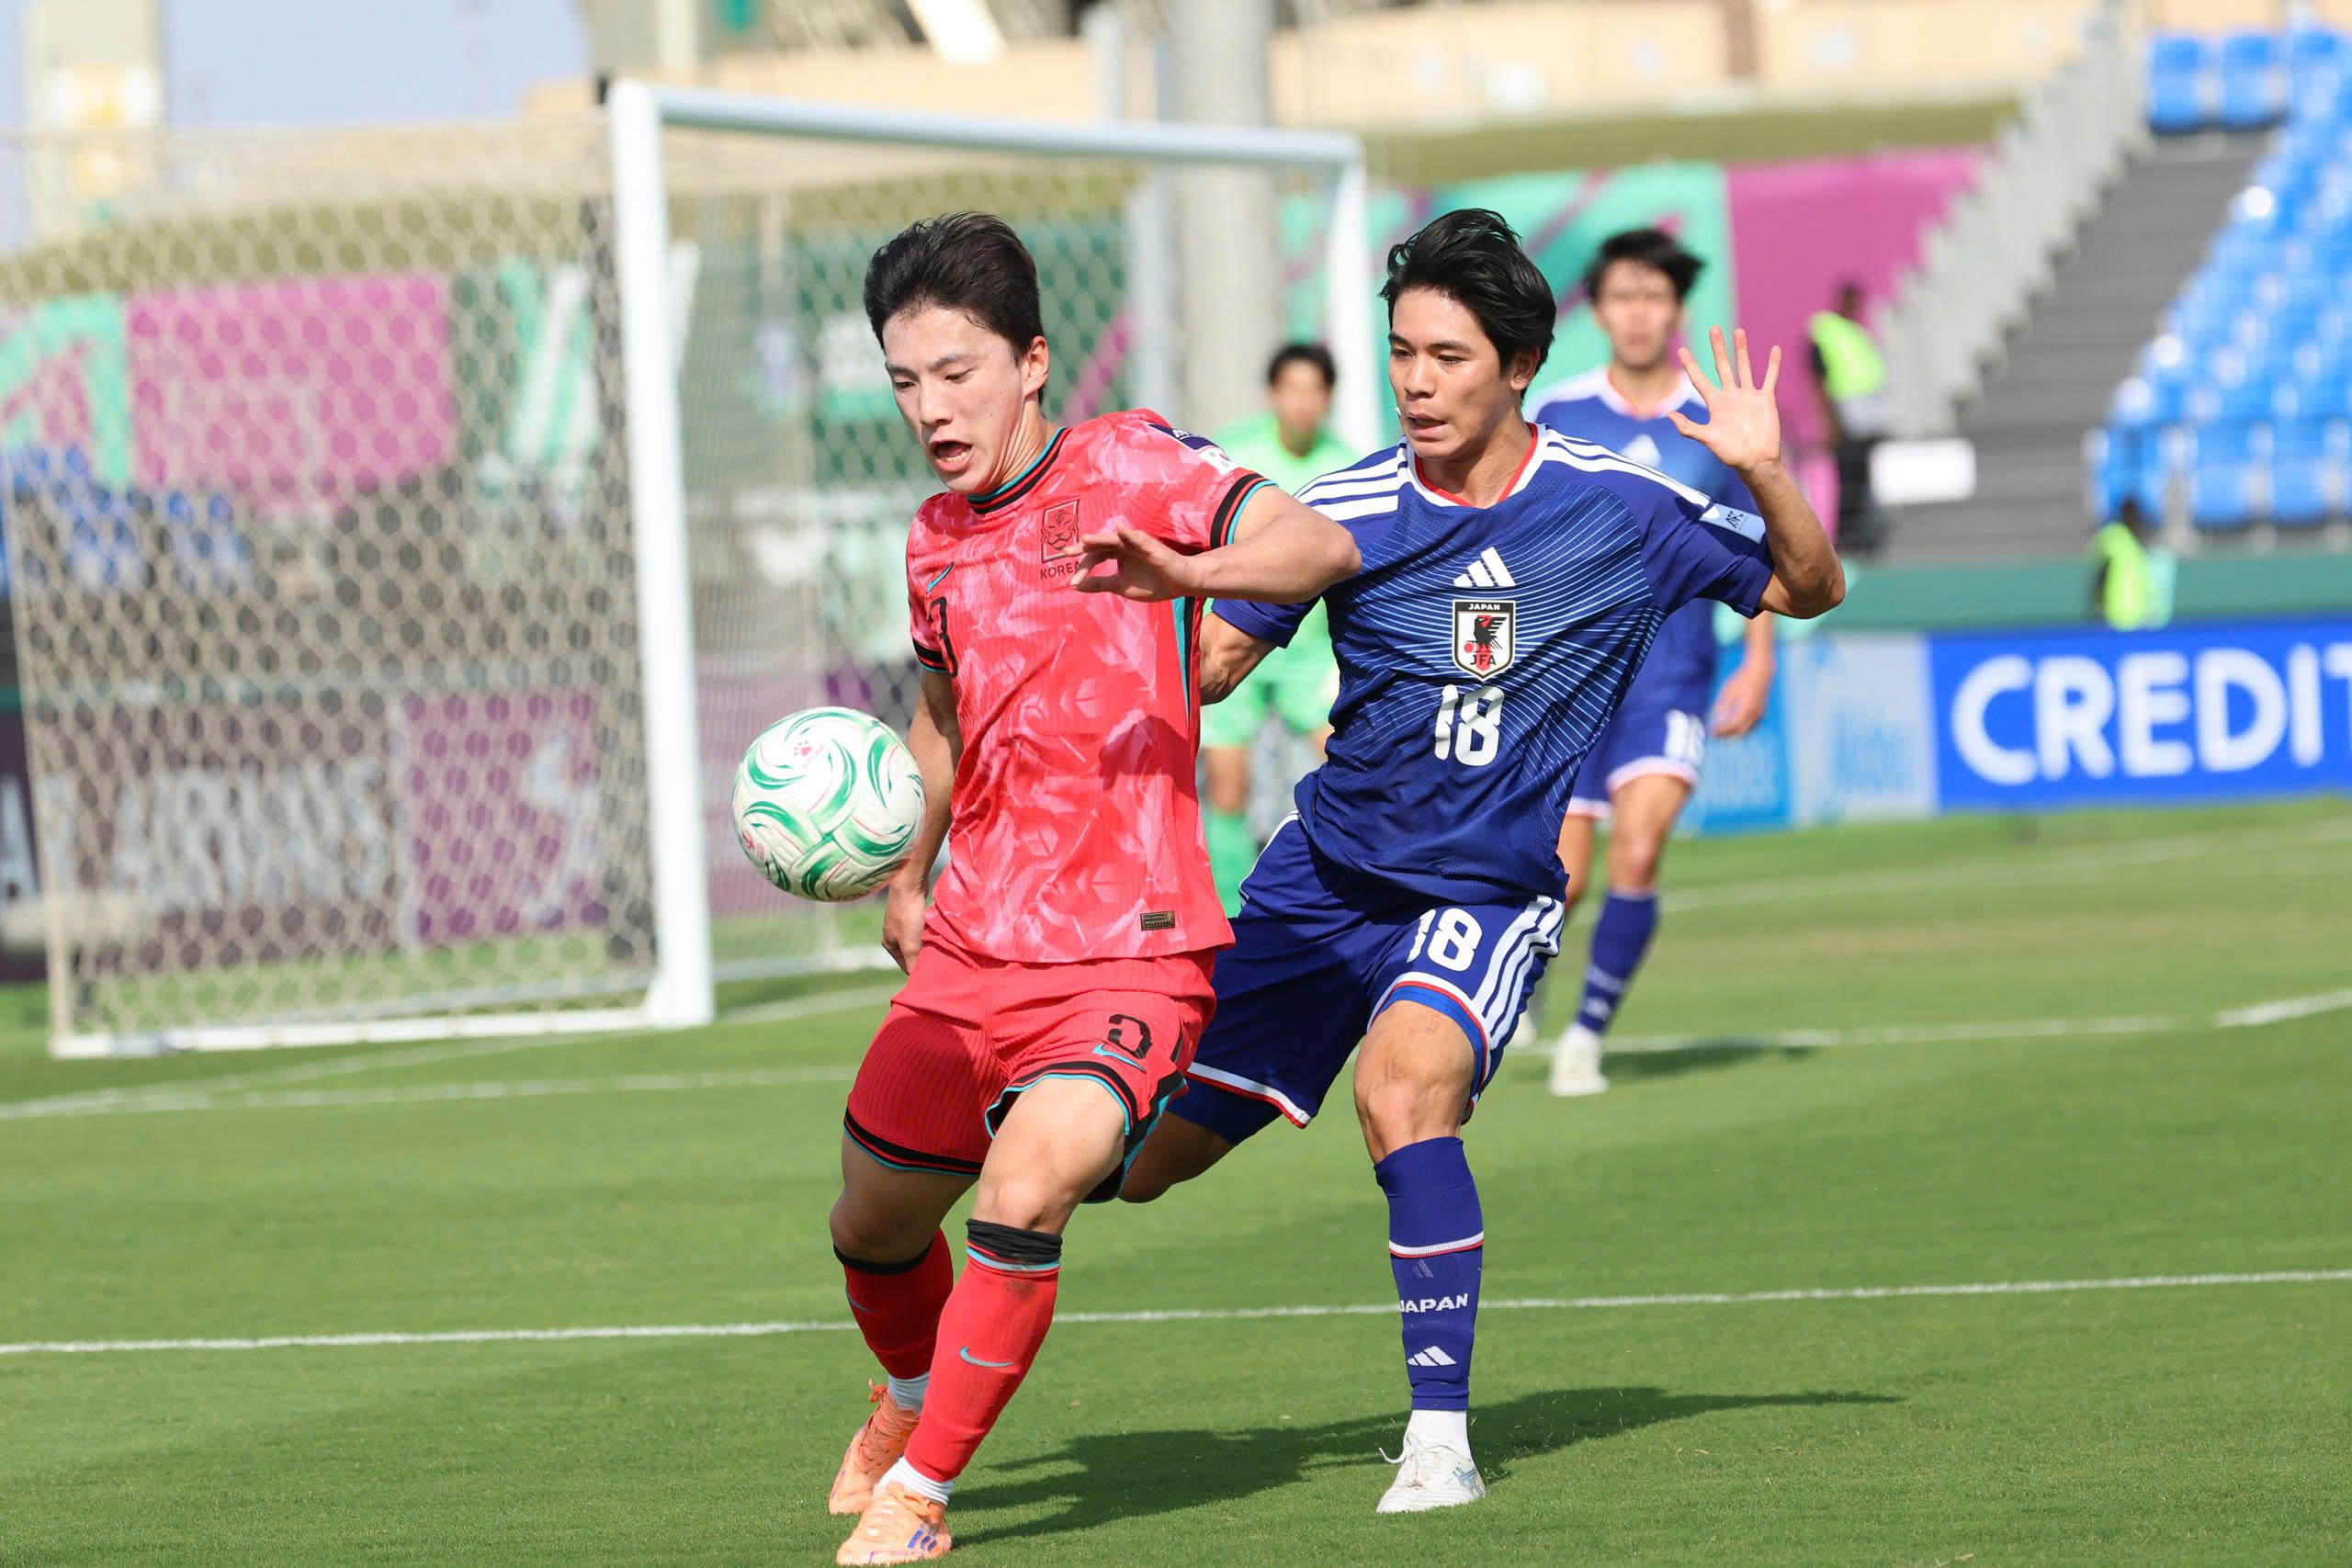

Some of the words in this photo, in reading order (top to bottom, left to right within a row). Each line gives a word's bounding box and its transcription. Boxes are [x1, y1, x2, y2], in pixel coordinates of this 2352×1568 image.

[1470, 654, 1497, 666] JFA
[1434, 683, 1505, 767] 18
[1407, 908, 1483, 972] 18
